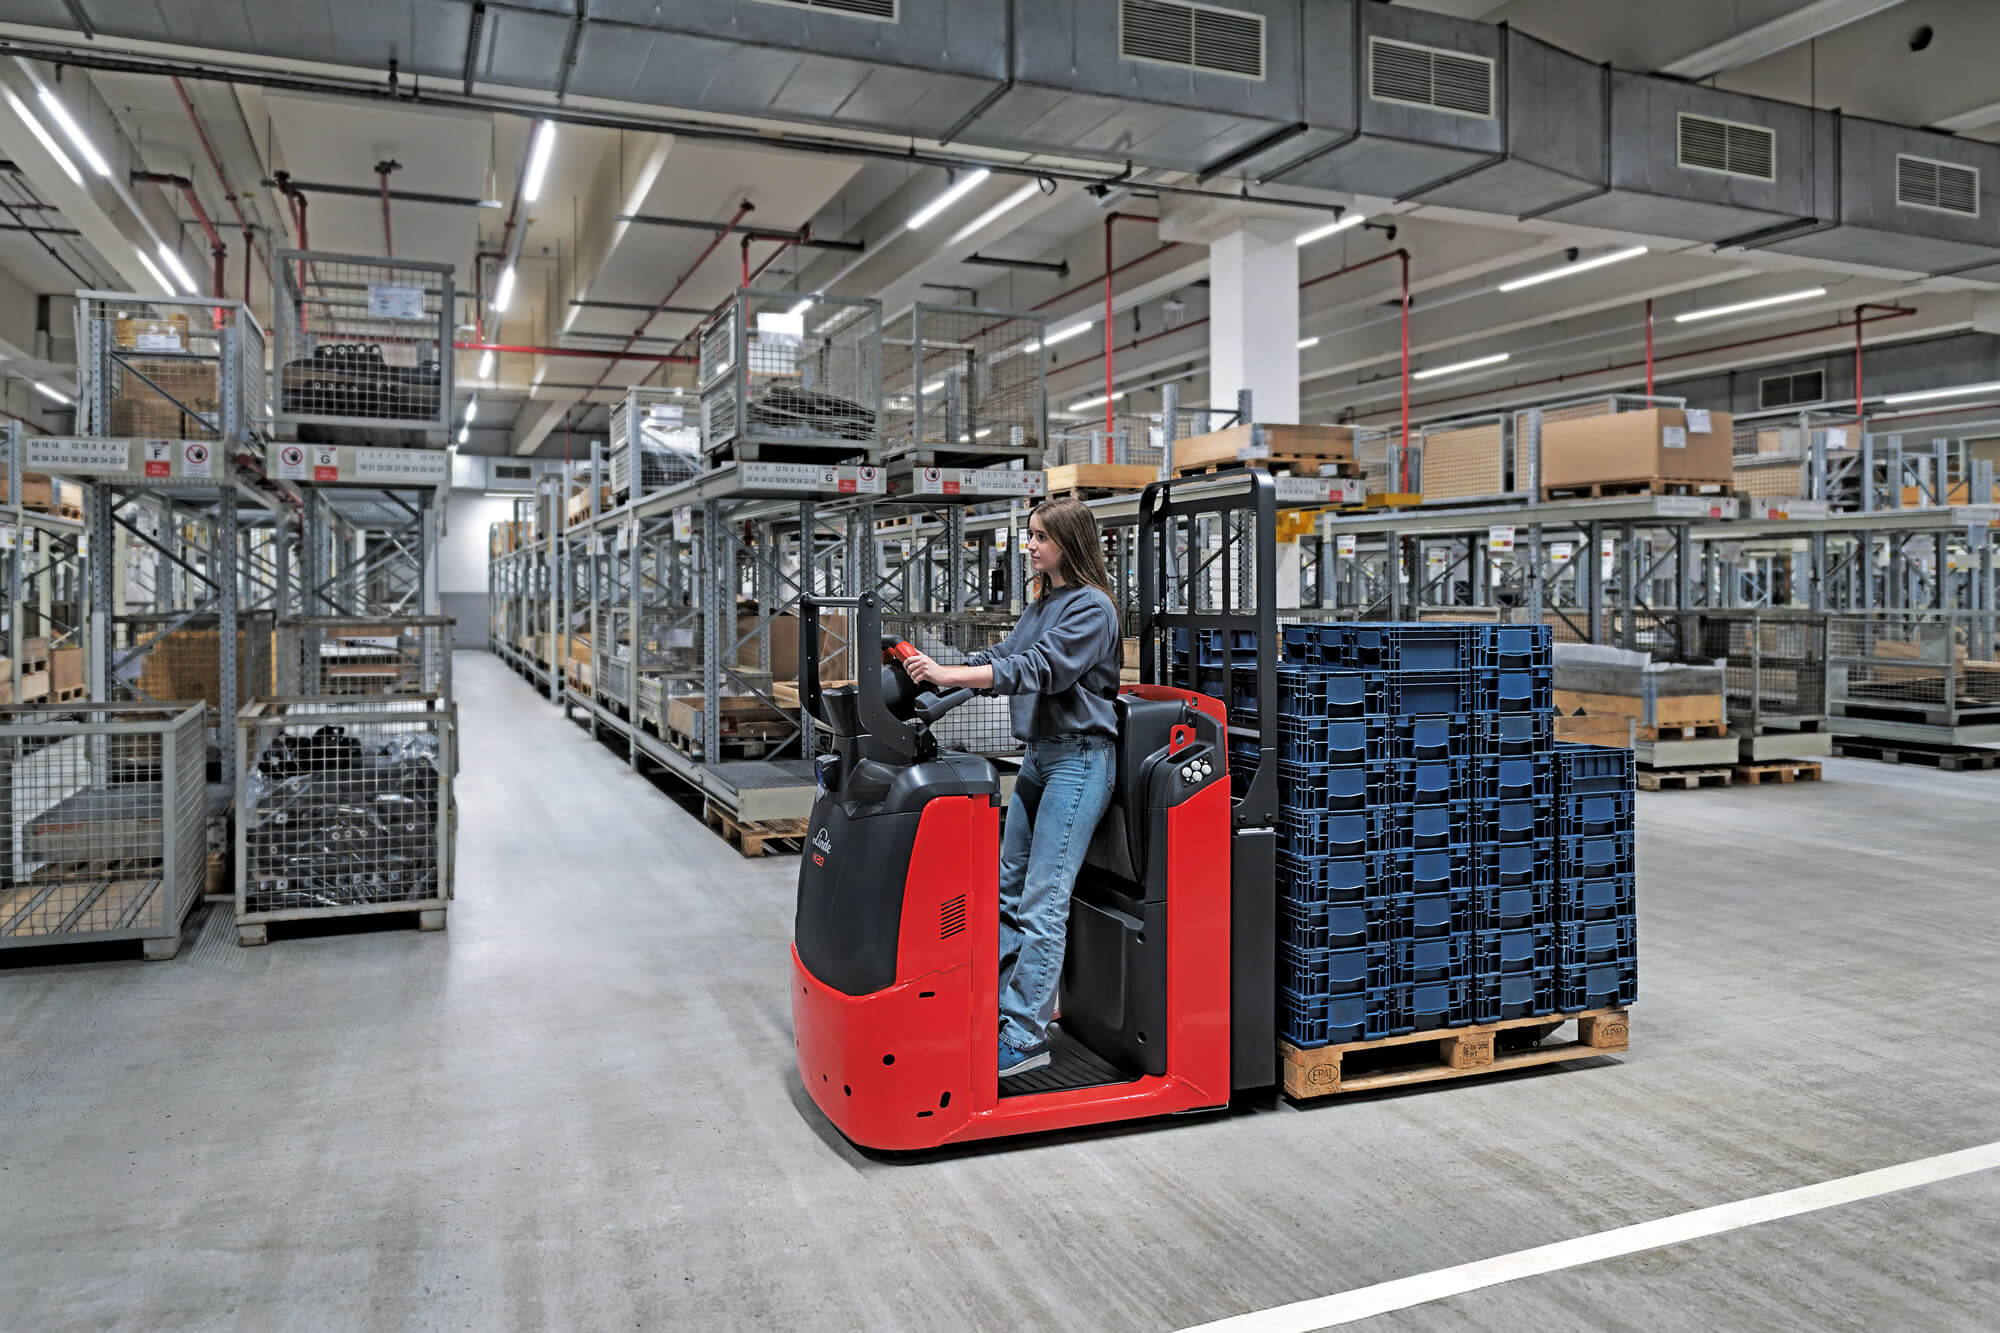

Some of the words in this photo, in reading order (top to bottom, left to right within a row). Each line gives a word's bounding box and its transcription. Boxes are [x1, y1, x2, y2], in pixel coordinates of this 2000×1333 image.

[154, 449, 162, 459] F
[320, 454, 331, 464] G
[825, 473, 833, 482] G
[812, 827, 831, 854] Linde
